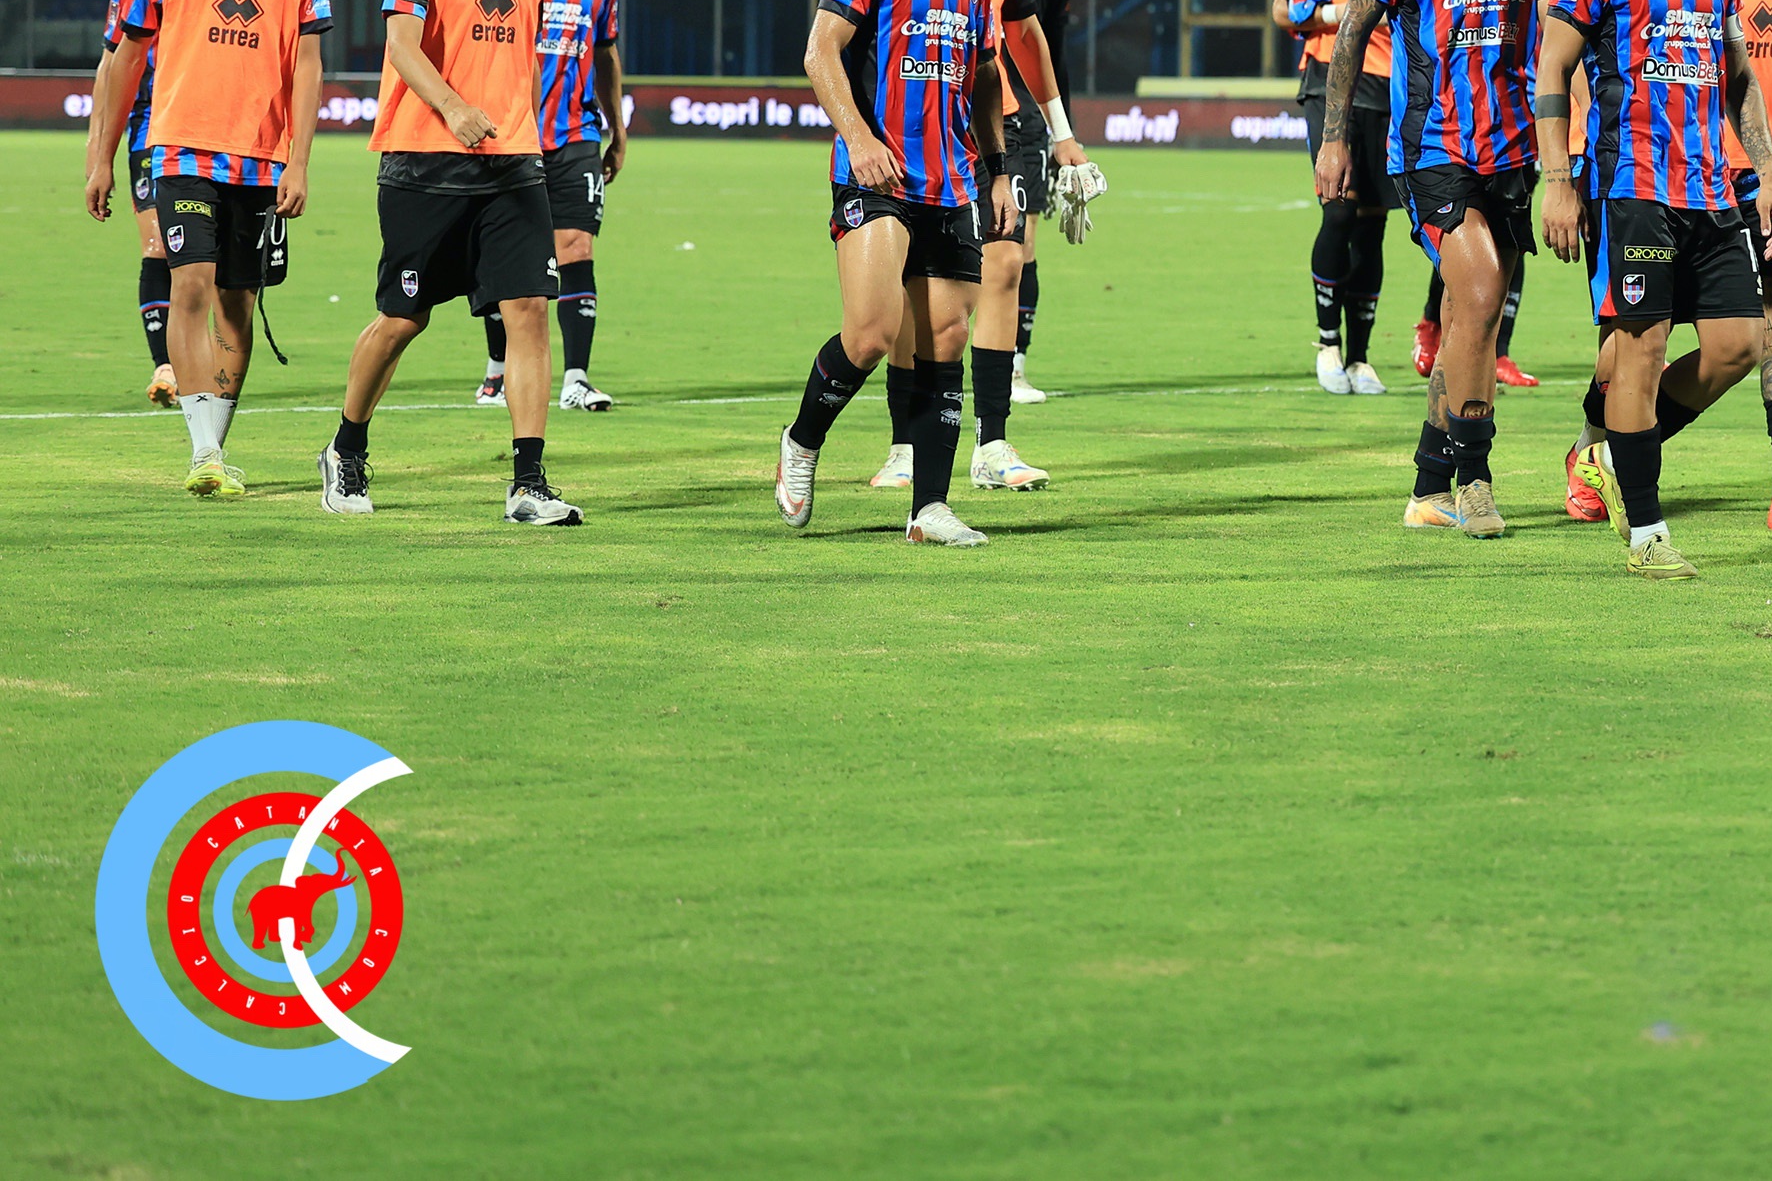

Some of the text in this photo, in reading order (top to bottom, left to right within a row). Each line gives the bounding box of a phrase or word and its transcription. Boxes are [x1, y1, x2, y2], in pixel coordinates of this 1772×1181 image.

[1665, 9, 1716, 27] SUPER
[670, 95, 760, 130] Scopri
[765, 97, 794, 126] le
[583, 172, 605, 205] 14
